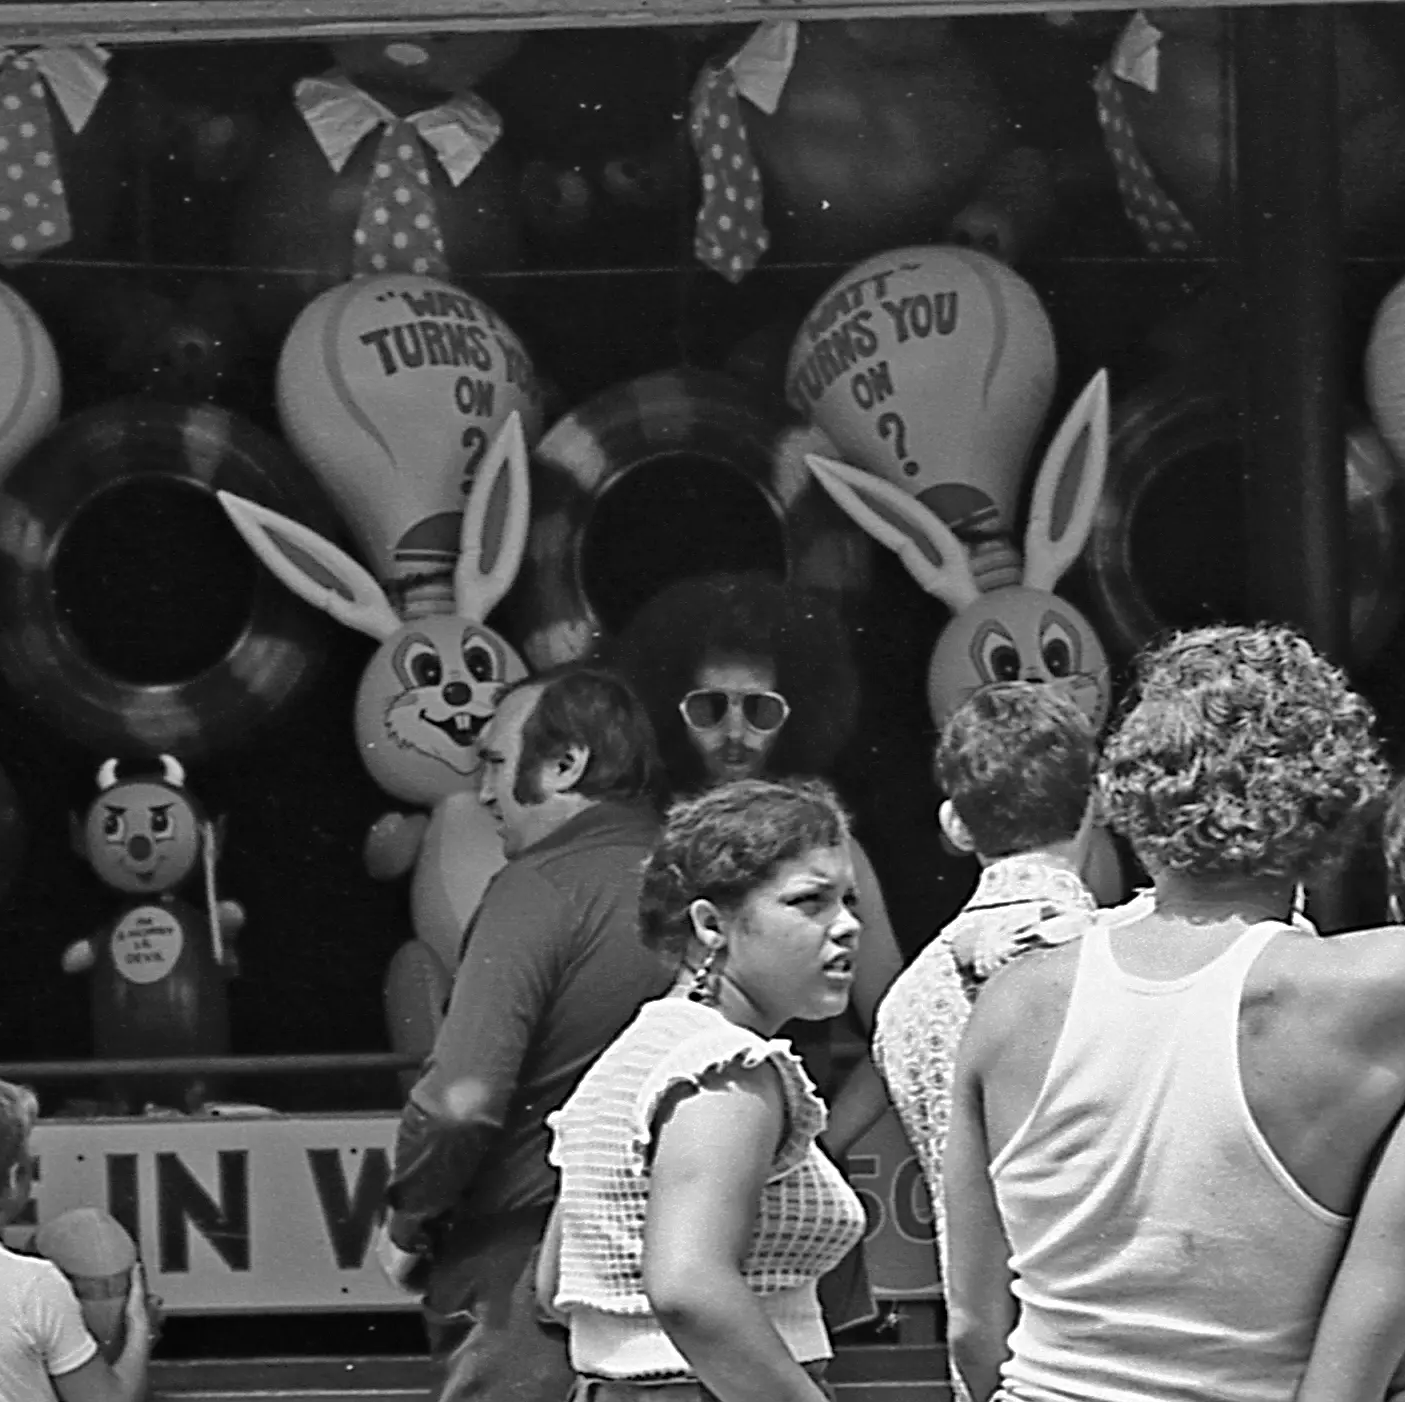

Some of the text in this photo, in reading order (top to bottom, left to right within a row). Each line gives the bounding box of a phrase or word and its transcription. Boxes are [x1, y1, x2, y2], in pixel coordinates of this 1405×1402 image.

[880, 260, 958, 343] YOU
[359, 319, 493, 376] TURNS
[454, 375, 496, 418] ON
[850, 359, 895, 411] ON
[876, 412, 920, 478] ?
[104, 1148, 251, 1273] IN
